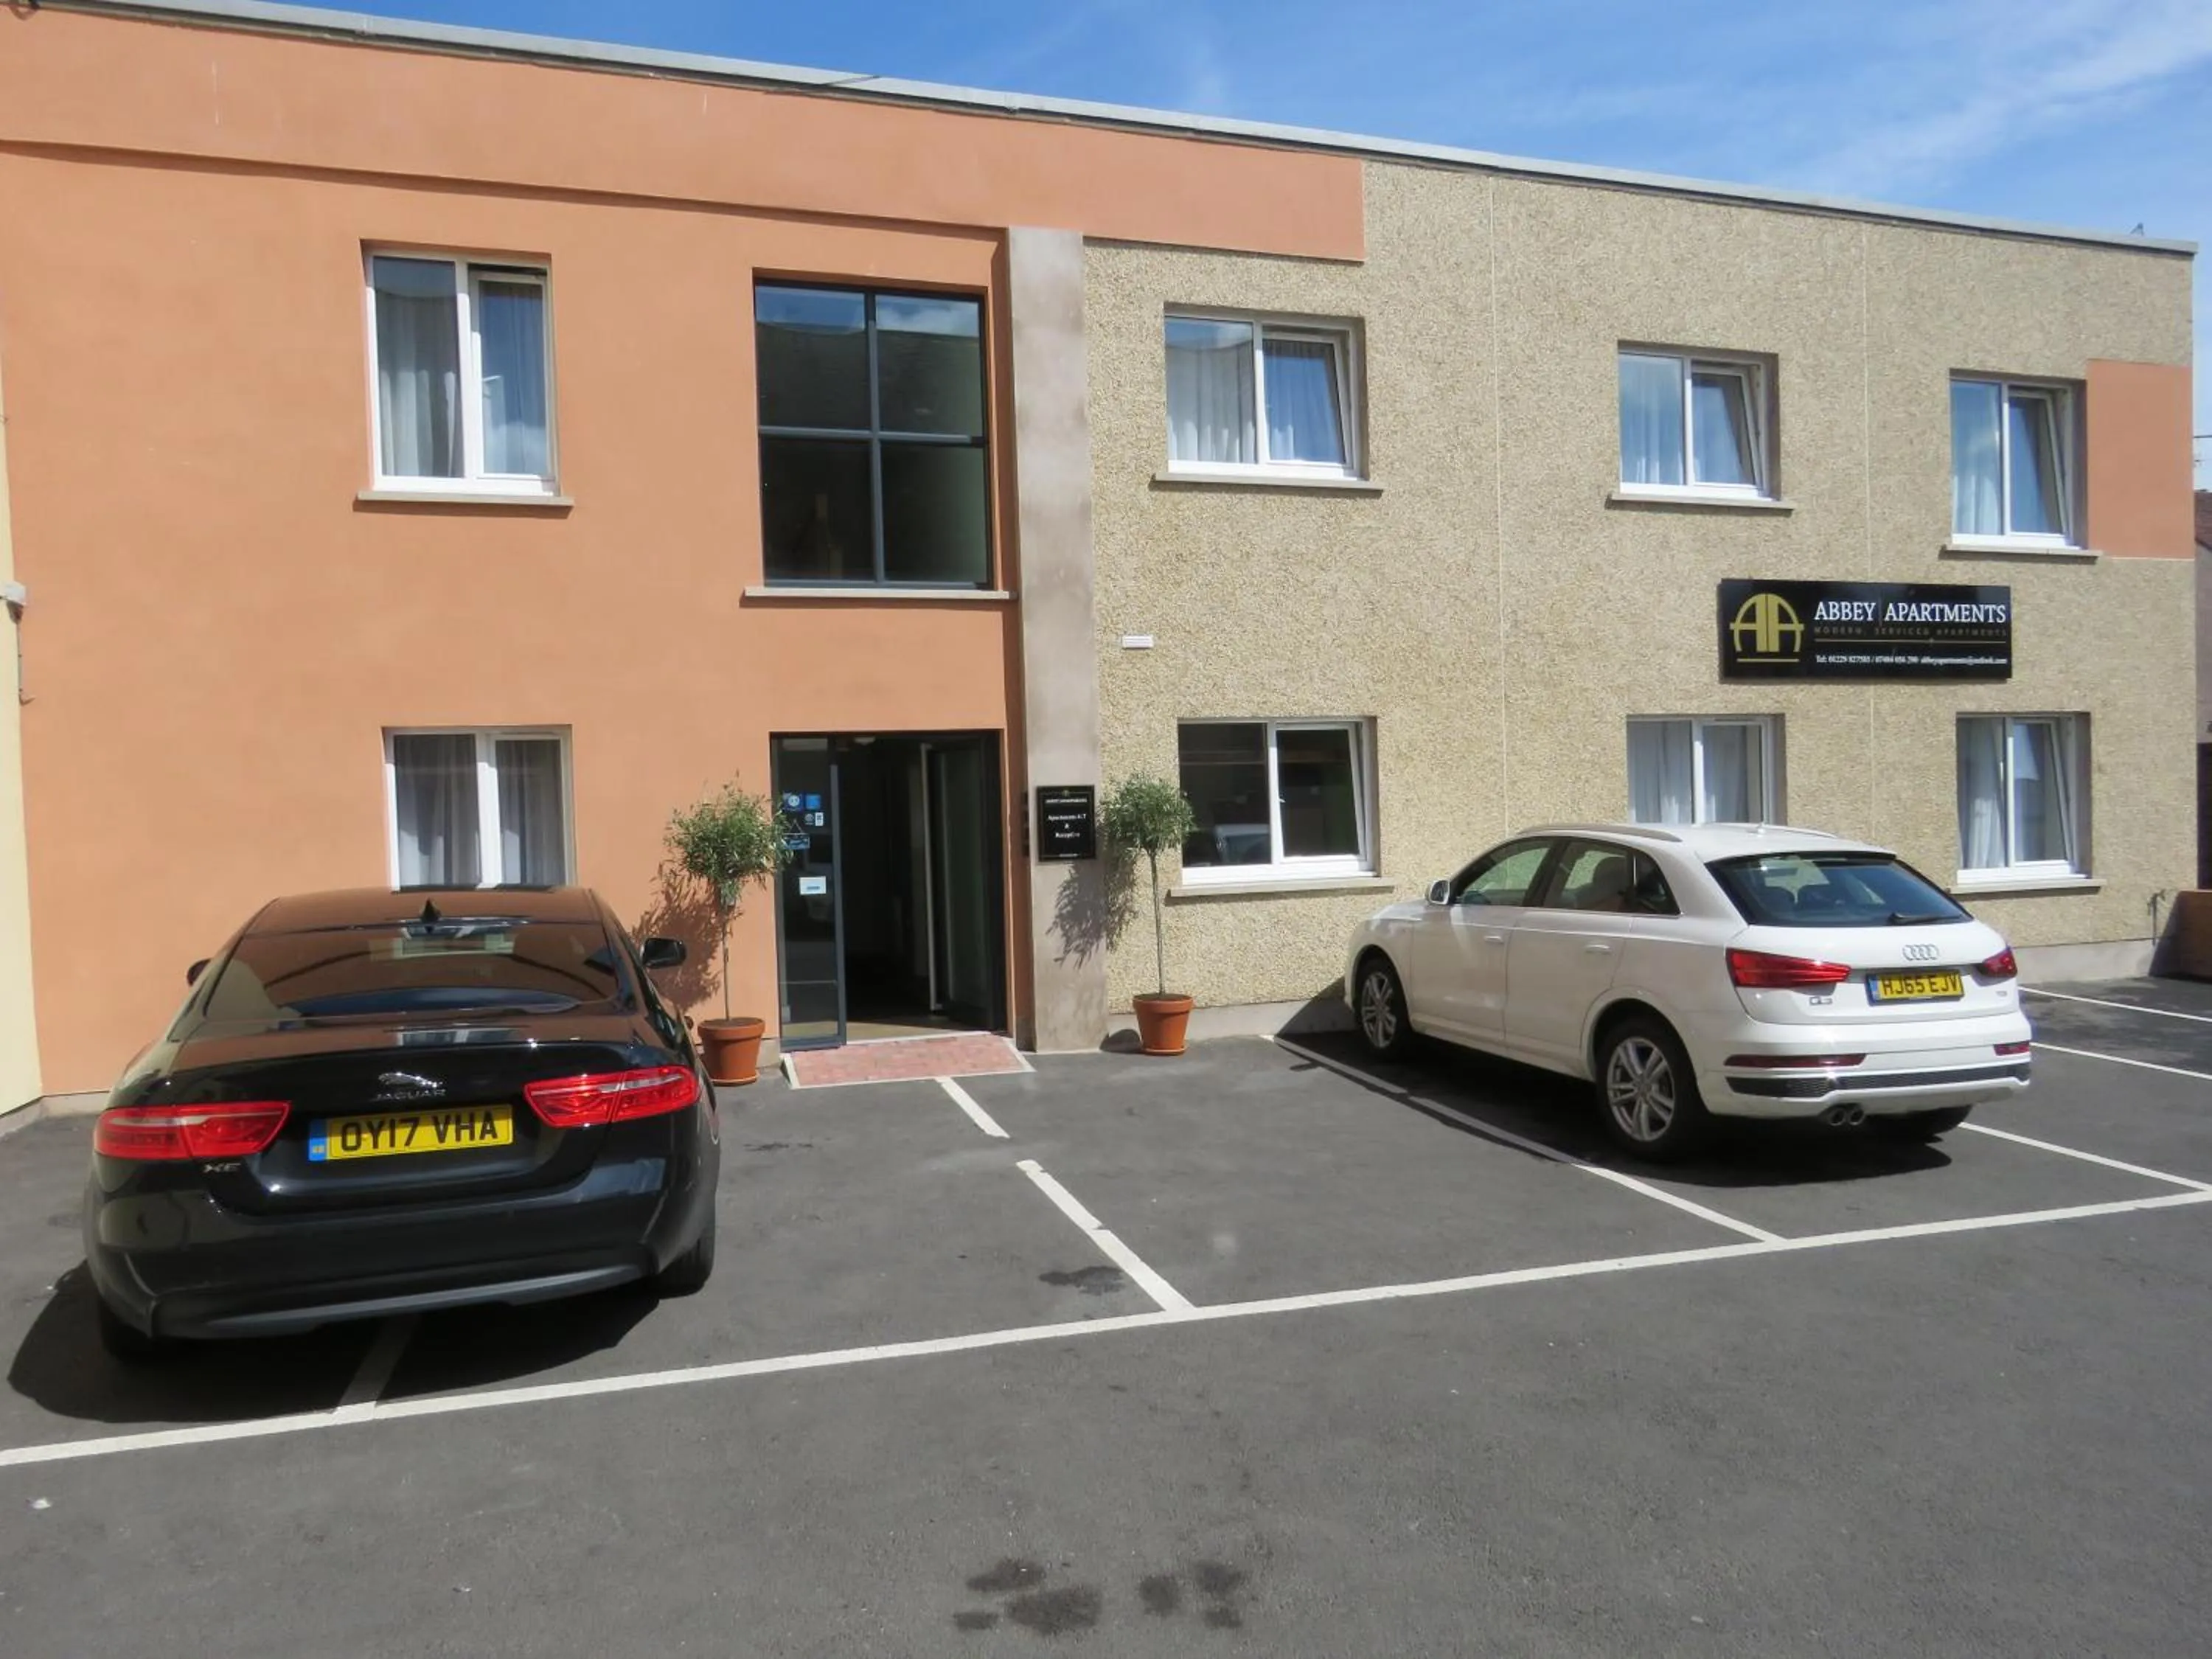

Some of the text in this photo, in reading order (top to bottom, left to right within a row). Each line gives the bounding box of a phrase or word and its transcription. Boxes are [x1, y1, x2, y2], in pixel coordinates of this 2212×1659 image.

[1814, 601, 2006, 623] ABBEY APARTMENTS
[1882, 973, 1960, 996] HJ65 EJV
[341, 1110, 498, 1152] OY17 VHA
